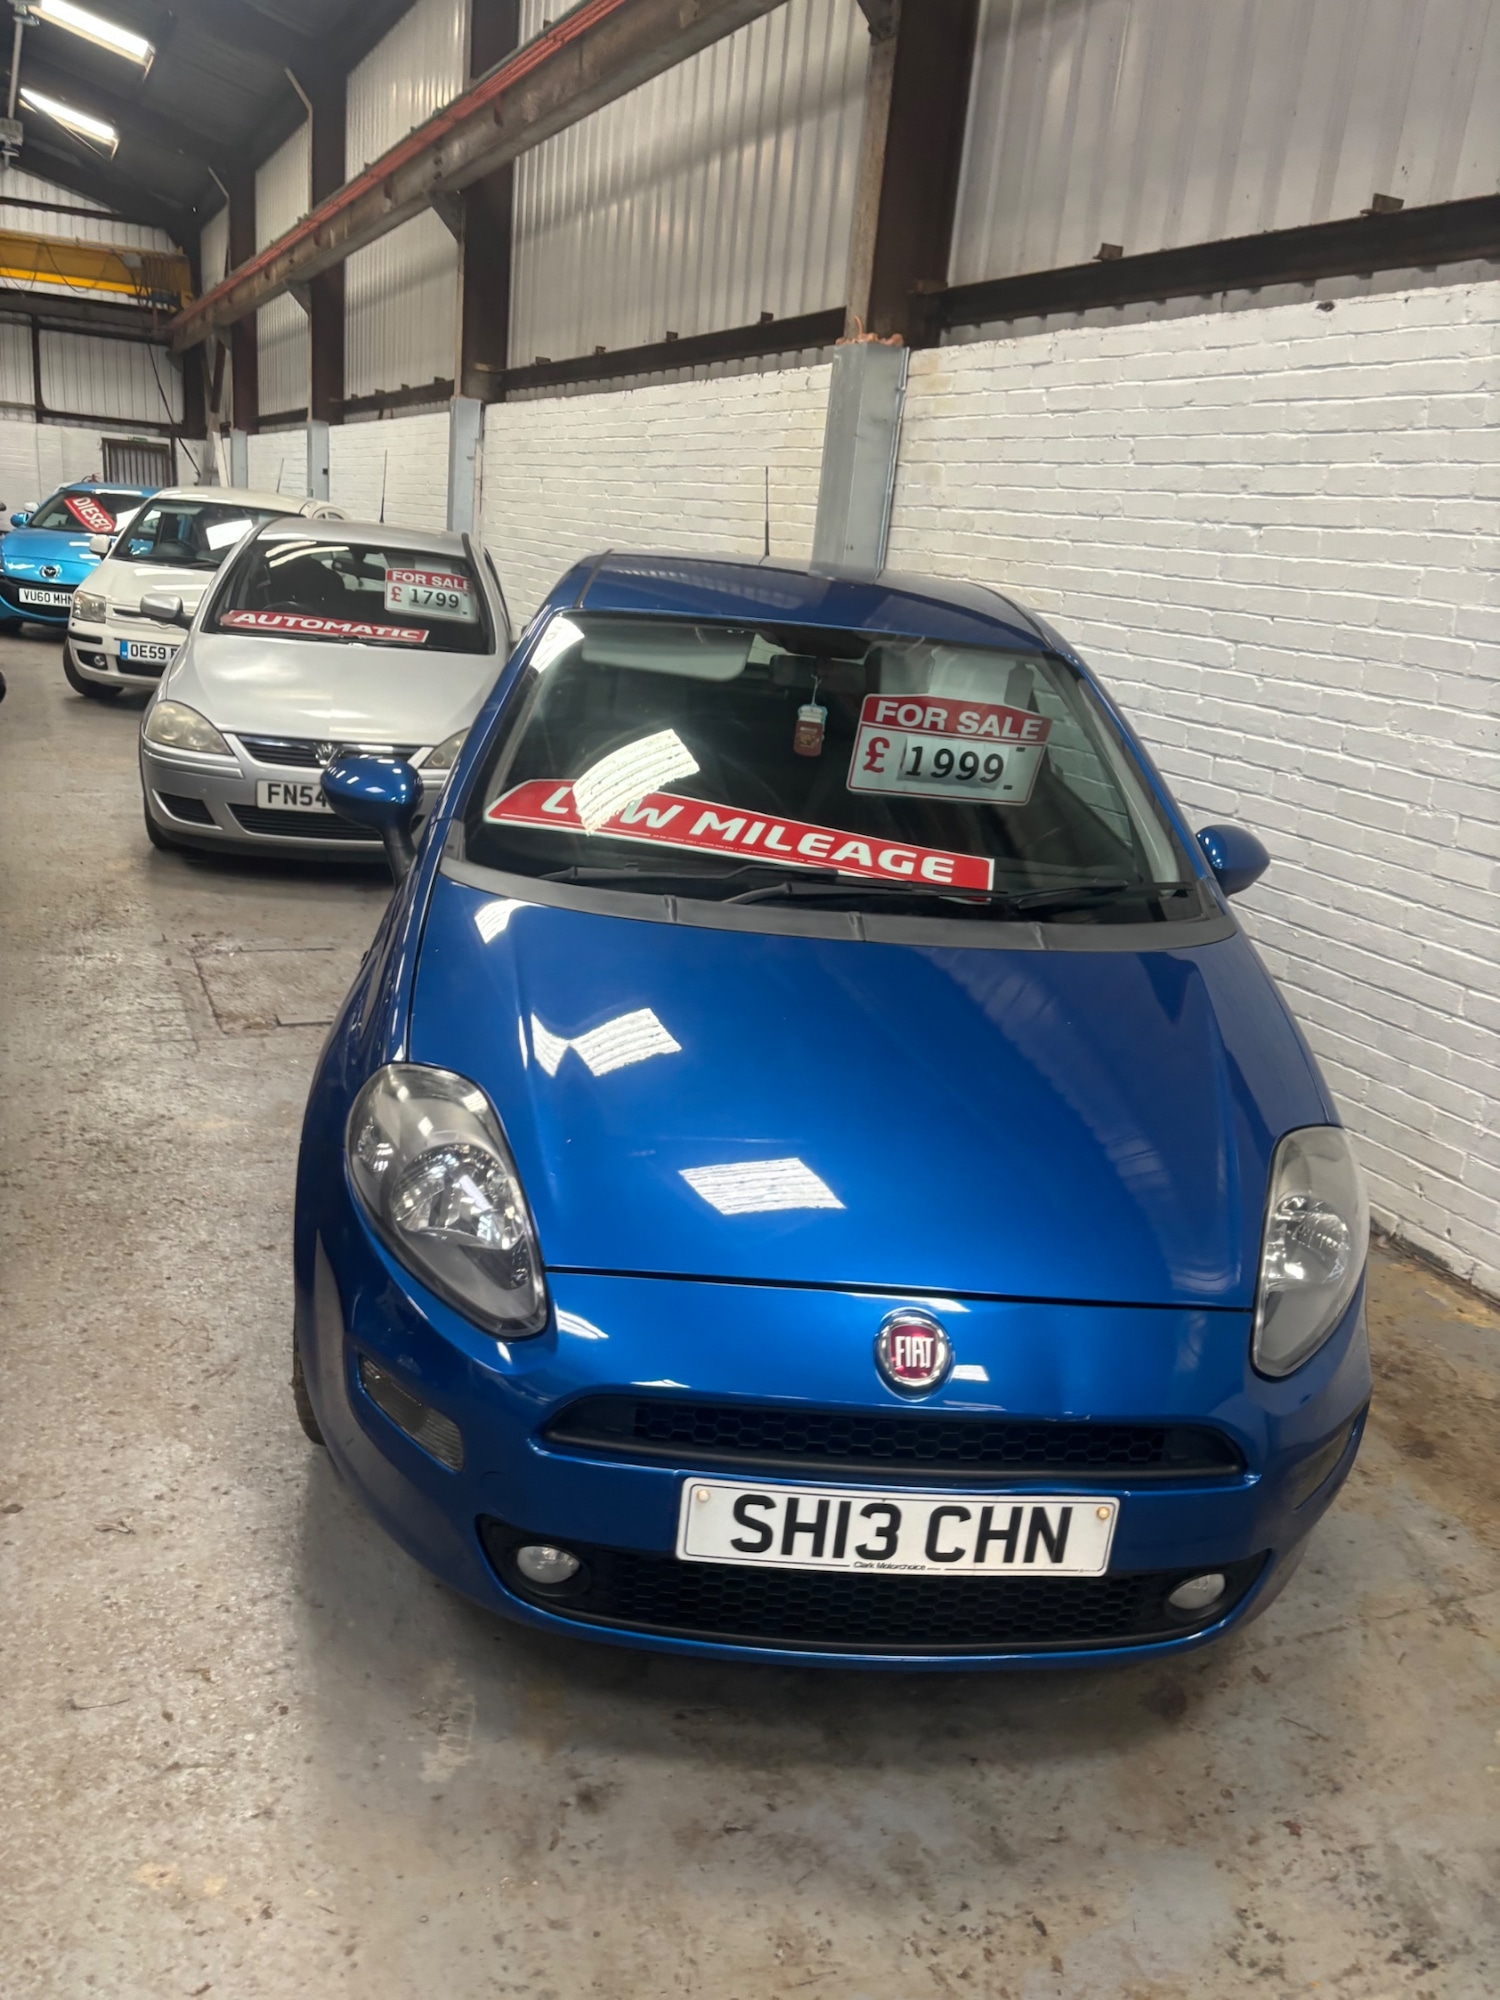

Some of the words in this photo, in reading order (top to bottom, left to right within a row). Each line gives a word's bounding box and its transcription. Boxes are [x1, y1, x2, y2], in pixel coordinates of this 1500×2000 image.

[73, 496, 112, 531] DIESEL
[392, 571, 426, 584] FOR
[431, 576, 473, 590] SALE
[24, 590, 51, 603] VU60
[411, 588, 459, 609] 1799
[234, 614, 420, 639] AUTOMATIC
[130, 644, 166, 660] OE59
[875, 700, 948, 731] FOR
[956, 711, 1042, 740] SALE
[905, 746, 1004, 783] 1999
[267, 783, 327, 808] FN54
[541, 786, 685, 829] LW
[688, 811, 955, 884] MILEAGE
[894, 1335, 934, 1368] FIAT
[730, 1494, 902, 1560] SH13
[924, 1505, 1073, 1564] CHN
